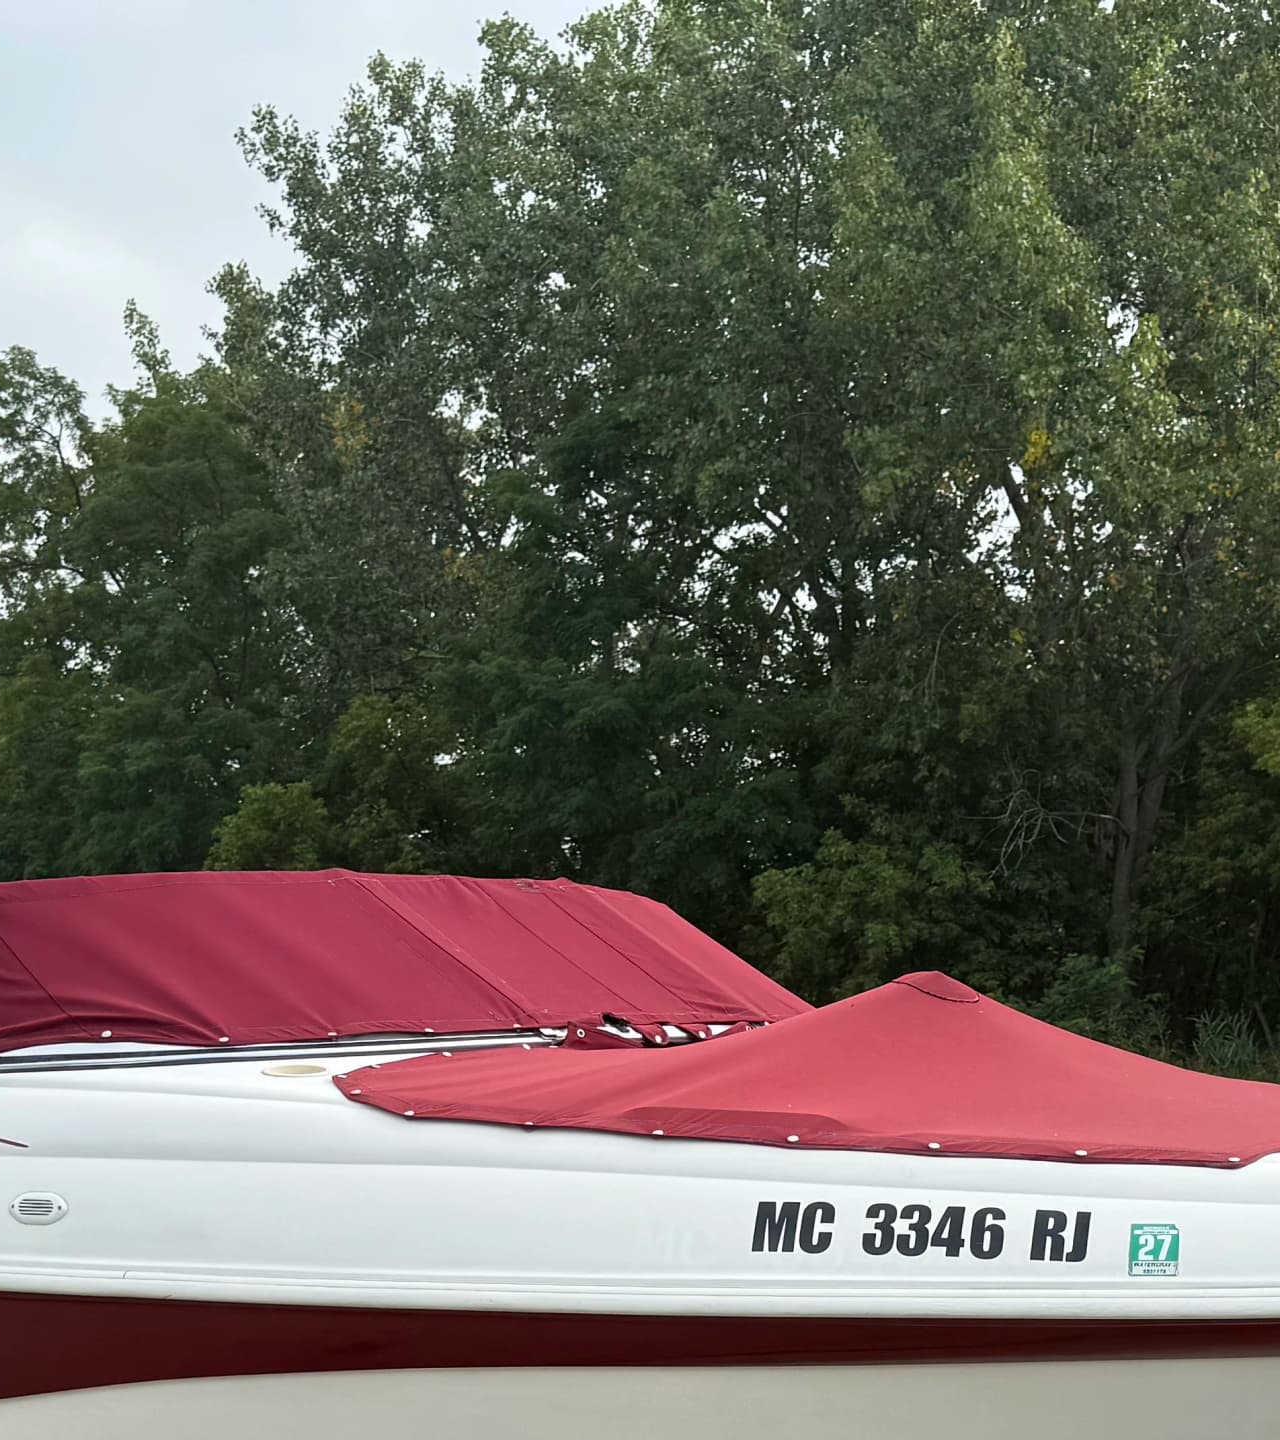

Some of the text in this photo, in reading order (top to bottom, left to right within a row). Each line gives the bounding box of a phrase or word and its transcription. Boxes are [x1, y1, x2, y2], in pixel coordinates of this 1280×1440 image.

[752, 1201, 1092, 1263] MC 3346 RJ
[1138, 1235, 1172, 1261] 27
